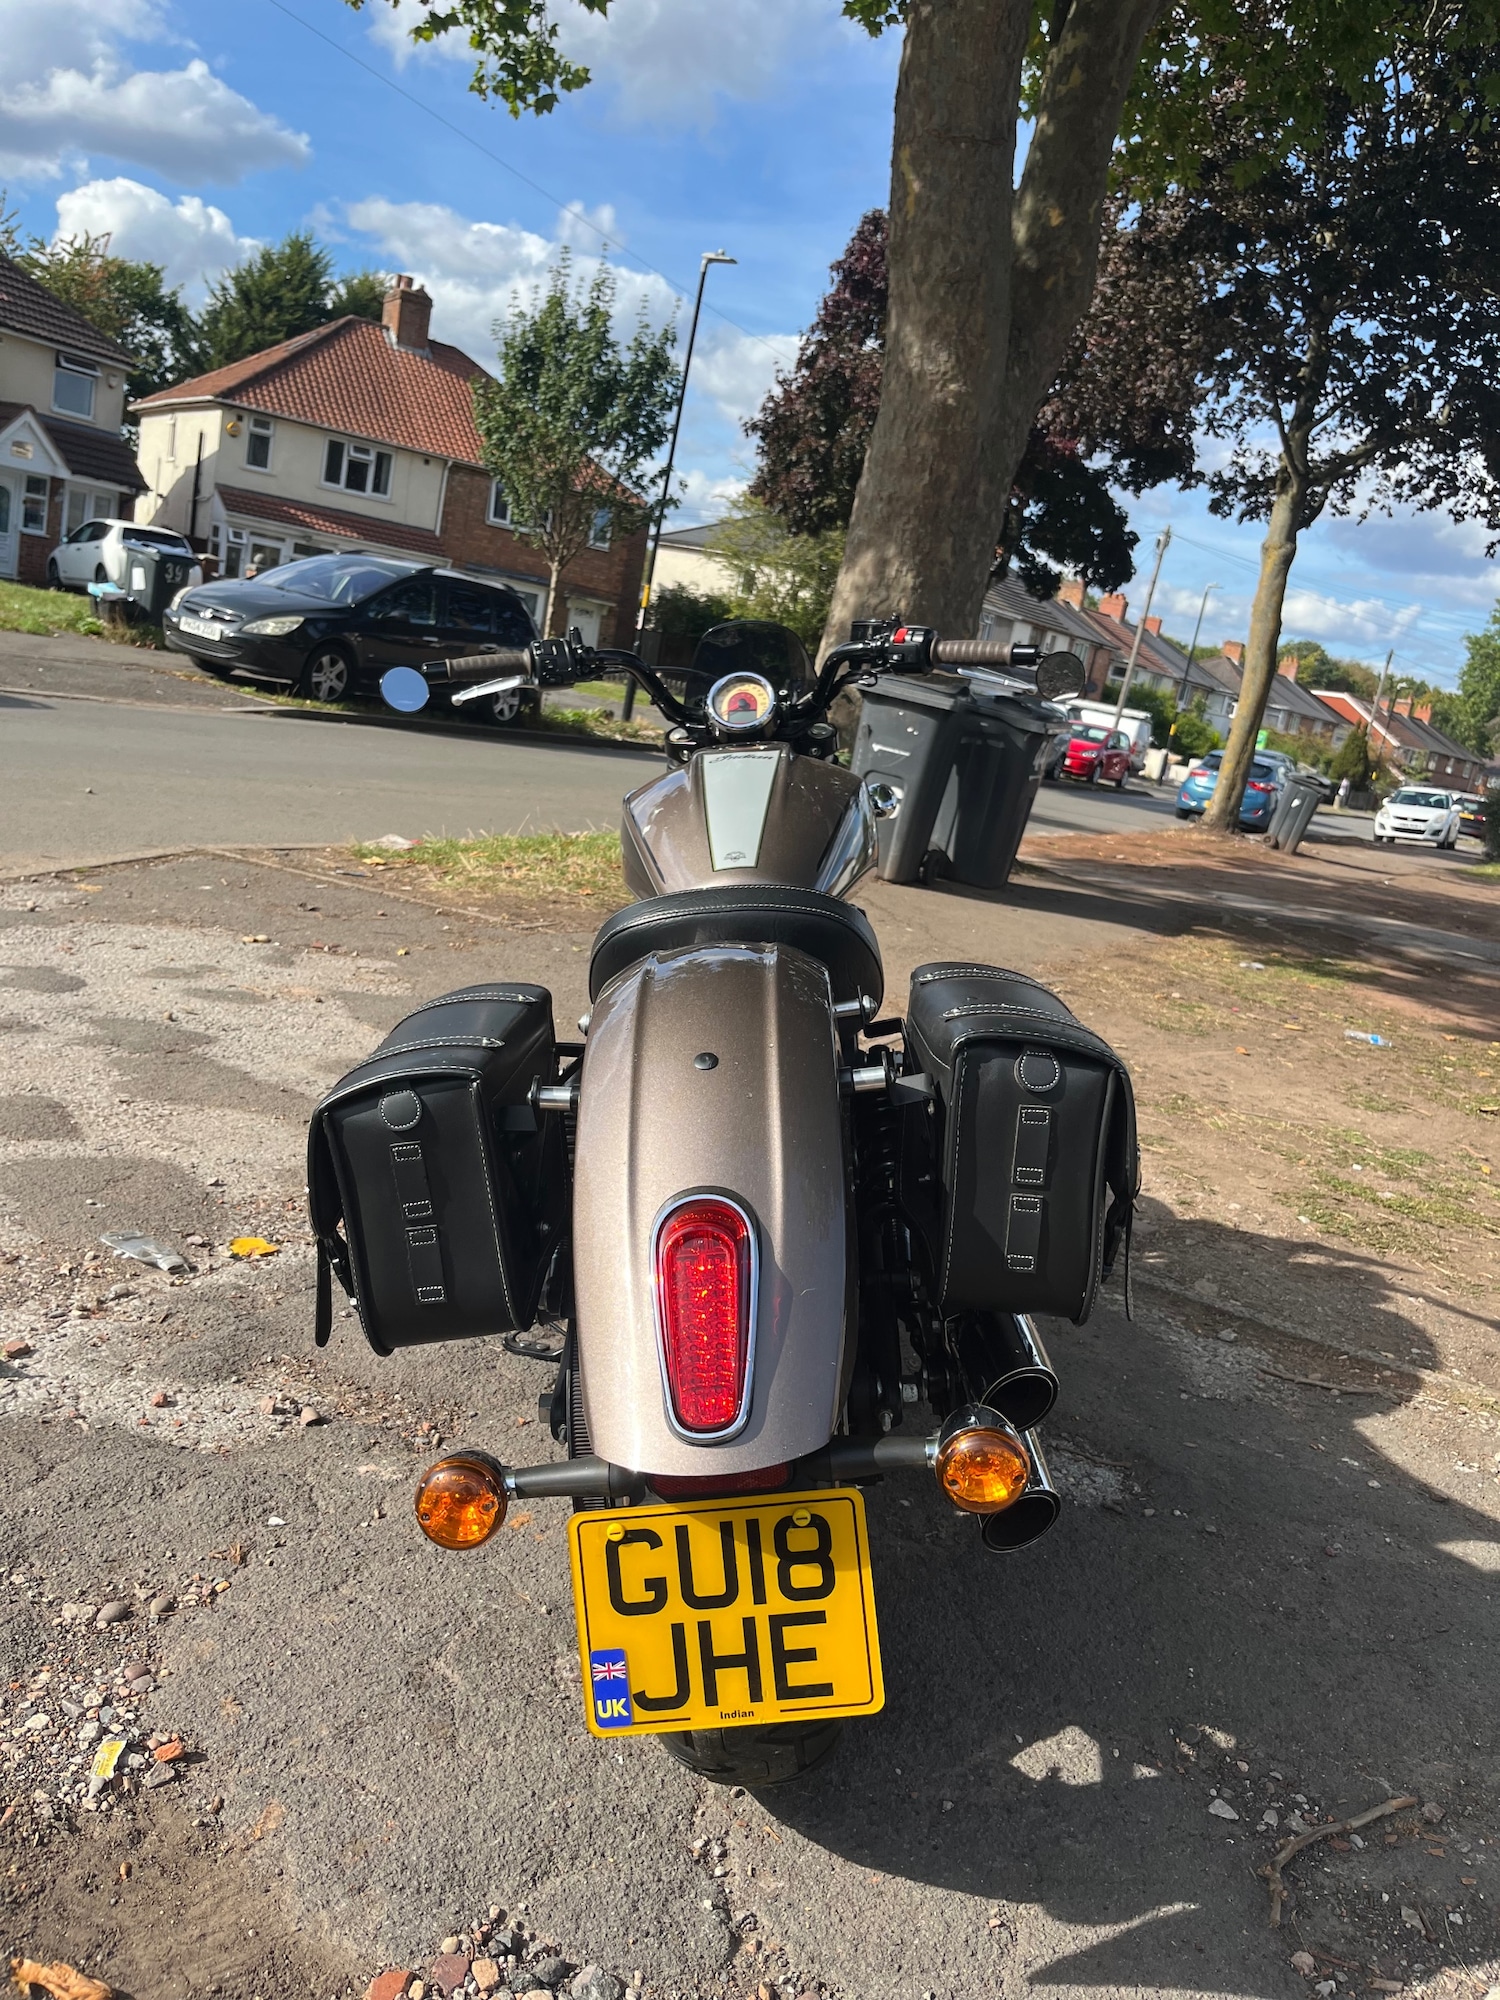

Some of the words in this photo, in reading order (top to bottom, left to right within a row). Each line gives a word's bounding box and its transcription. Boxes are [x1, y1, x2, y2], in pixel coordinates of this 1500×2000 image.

[164, 562, 184, 582] 39
[605, 1513, 836, 1616] GU18
[632, 1610, 834, 1712] JHE
[596, 1697, 630, 1719] UK
[720, 1709, 755, 1720] Indian
